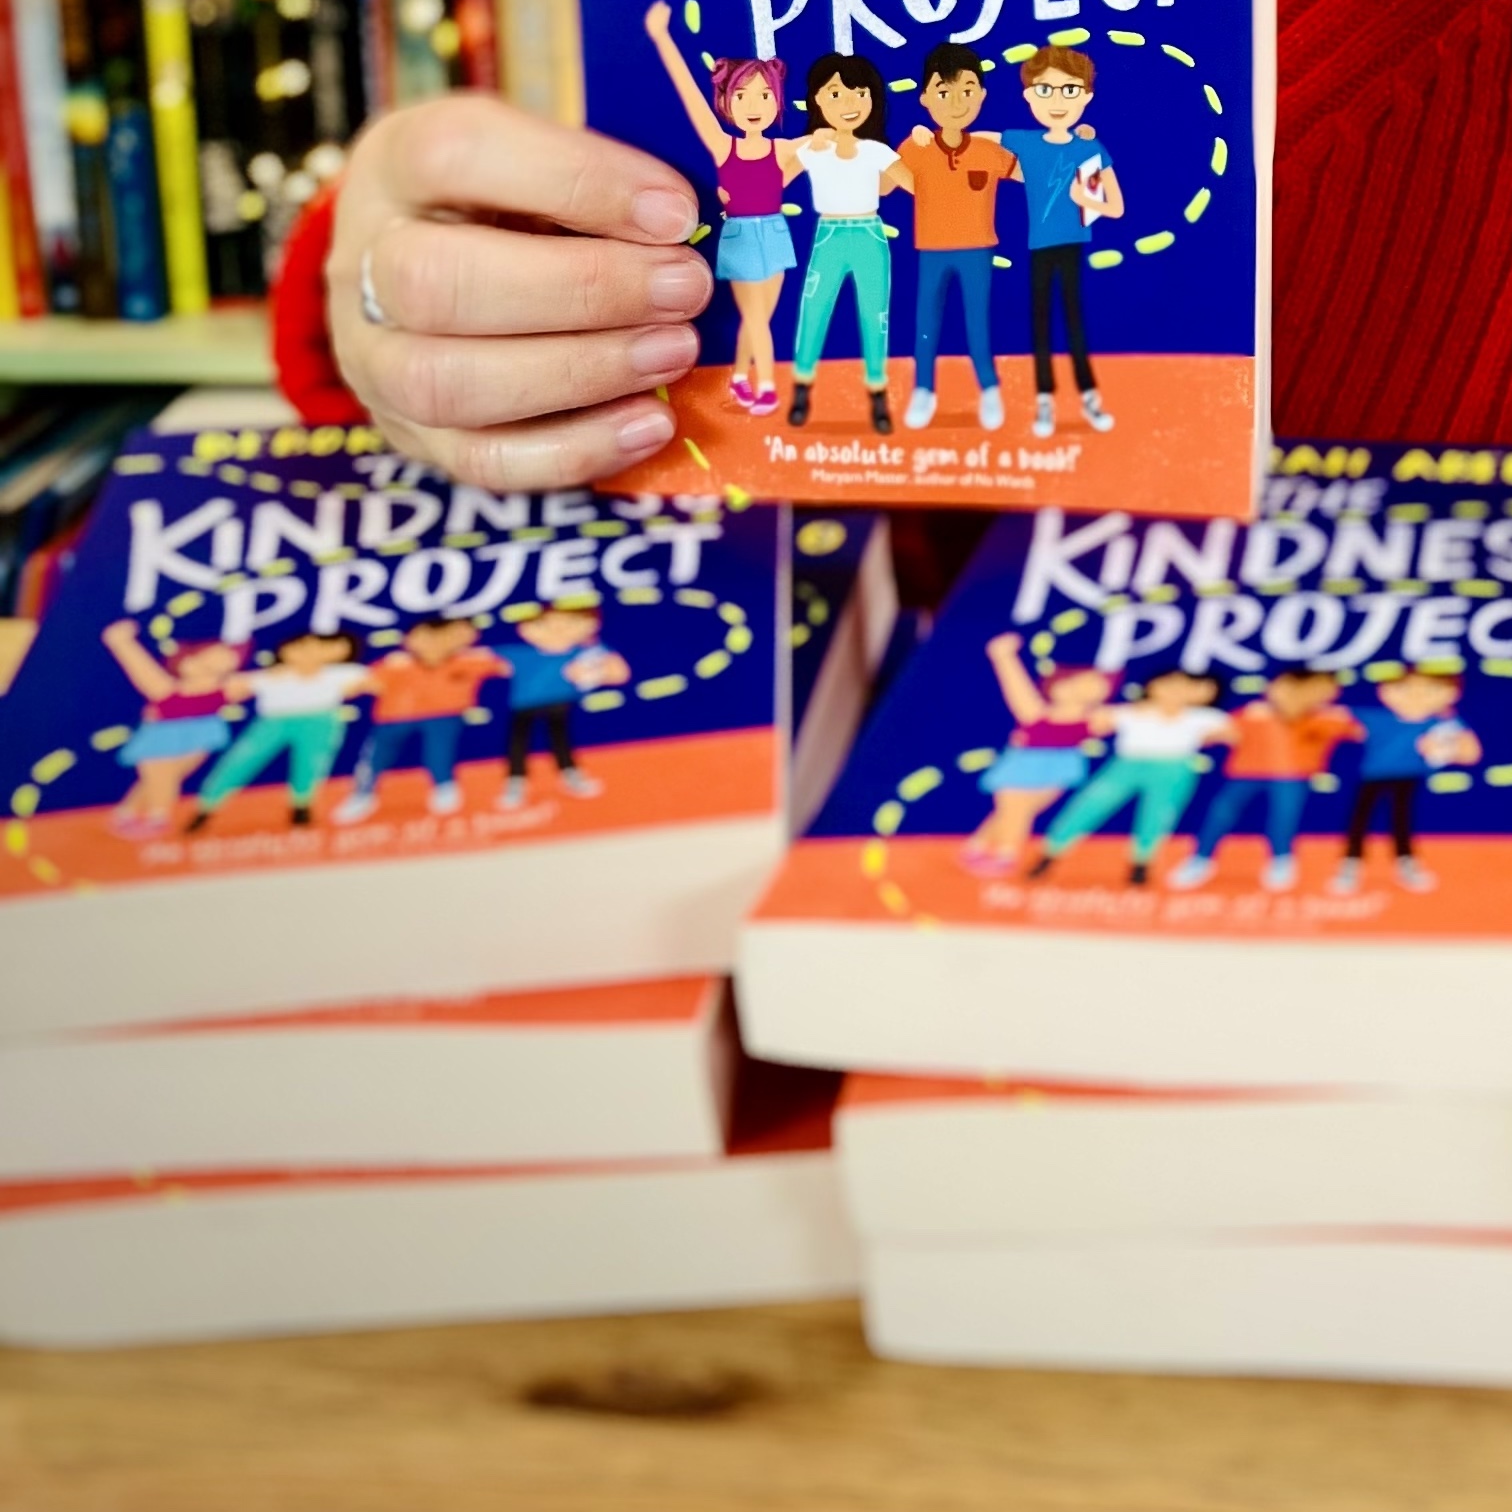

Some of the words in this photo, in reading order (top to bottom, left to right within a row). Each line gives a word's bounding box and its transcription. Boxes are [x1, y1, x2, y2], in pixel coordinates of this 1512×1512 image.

[803, 439, 905, 466] absolute
[911, 447, 959, 474] gem
[965, 441, 991, 468] of
[997, 449, 1012, 469] a
[221, 521, 724, 644] PROJECT
